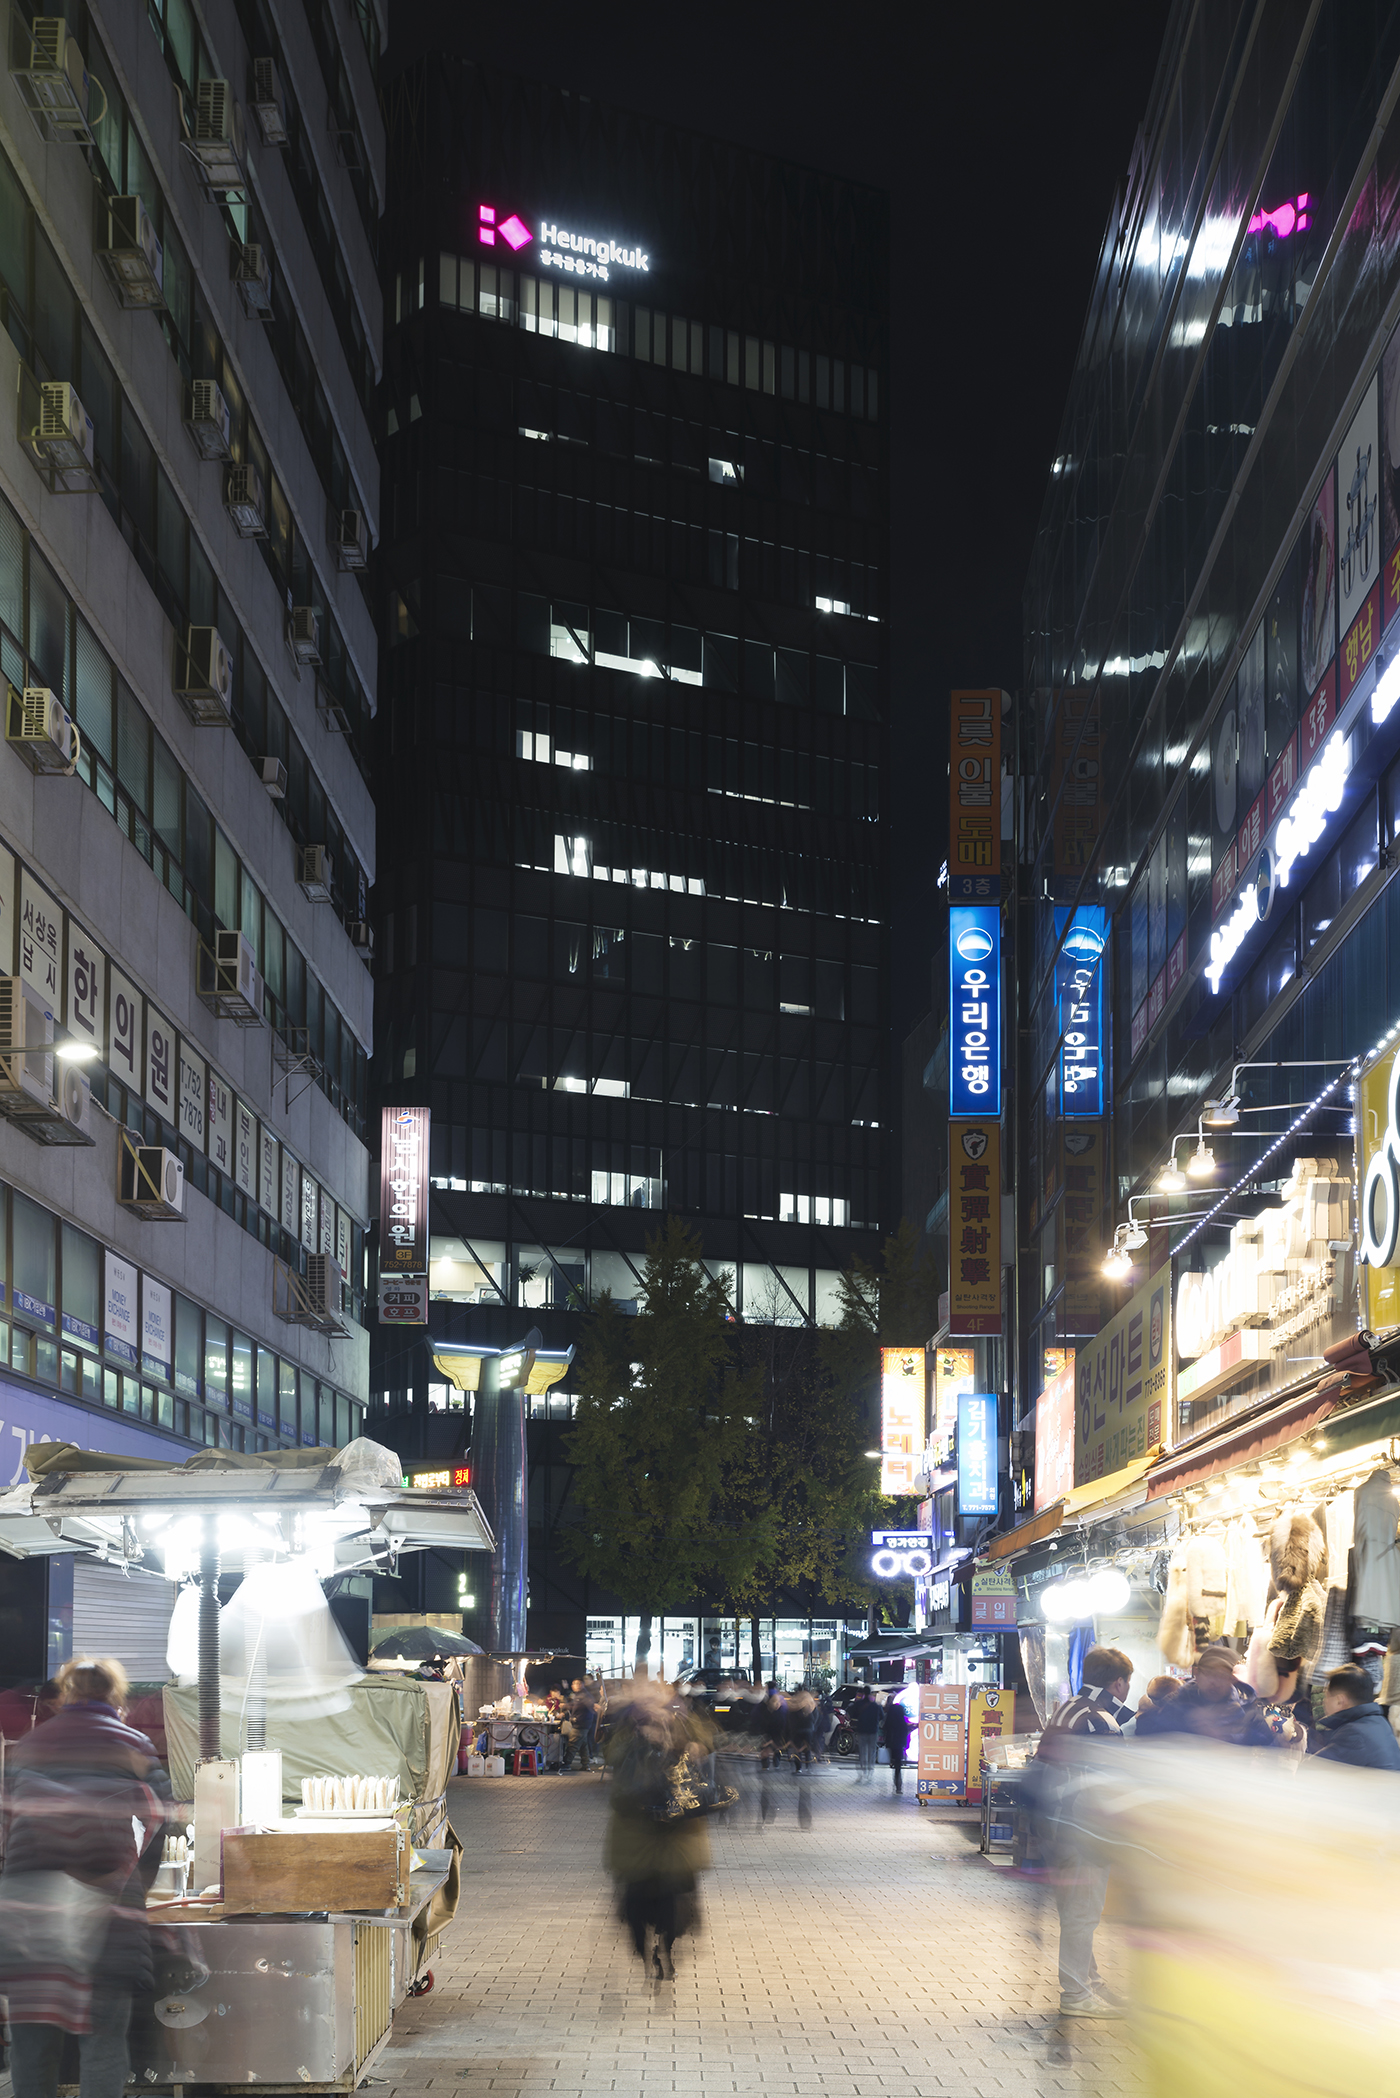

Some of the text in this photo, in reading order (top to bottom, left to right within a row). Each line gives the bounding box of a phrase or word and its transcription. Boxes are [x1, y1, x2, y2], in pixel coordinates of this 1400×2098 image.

[541, 222, 649, 272] Heungkuk
[1346, 601, 1374, 682] 행남
[958, 698, 993, 747] 그릇
[1308, 689, 1327, 748] 3층
[958, 758, 993, 807] 이불
[1271, 743, 1293, 815] 도매
[957, 817, 993, 866] 도매
[1241, 803, 1261, 855] 이불
[963, 878, 990, 895] 3층
[23, 899, 57, 956] 서상욱
[960, 969, 990, 1094] 우리은행
[388, 1133, 421, 1247] 남시한의원
[384, 1261, 423, 1269] 752-7878
[396, 1251, 412, 1259] 3F
[388, 1308, 415, 1318] 호프
[389, 1293, 415, 1304] 커피
[955, 1293, 996, 1302] 실탄사격장
[967, 1318, 985, 1331] 4F
[1079, 1308, 1144, 1446] 영선마트
[924, 1692, 960, 1711] 그릇
[923, 1723, 960, 1742] 이불
[923, 1754, 959, 1773] 도매
